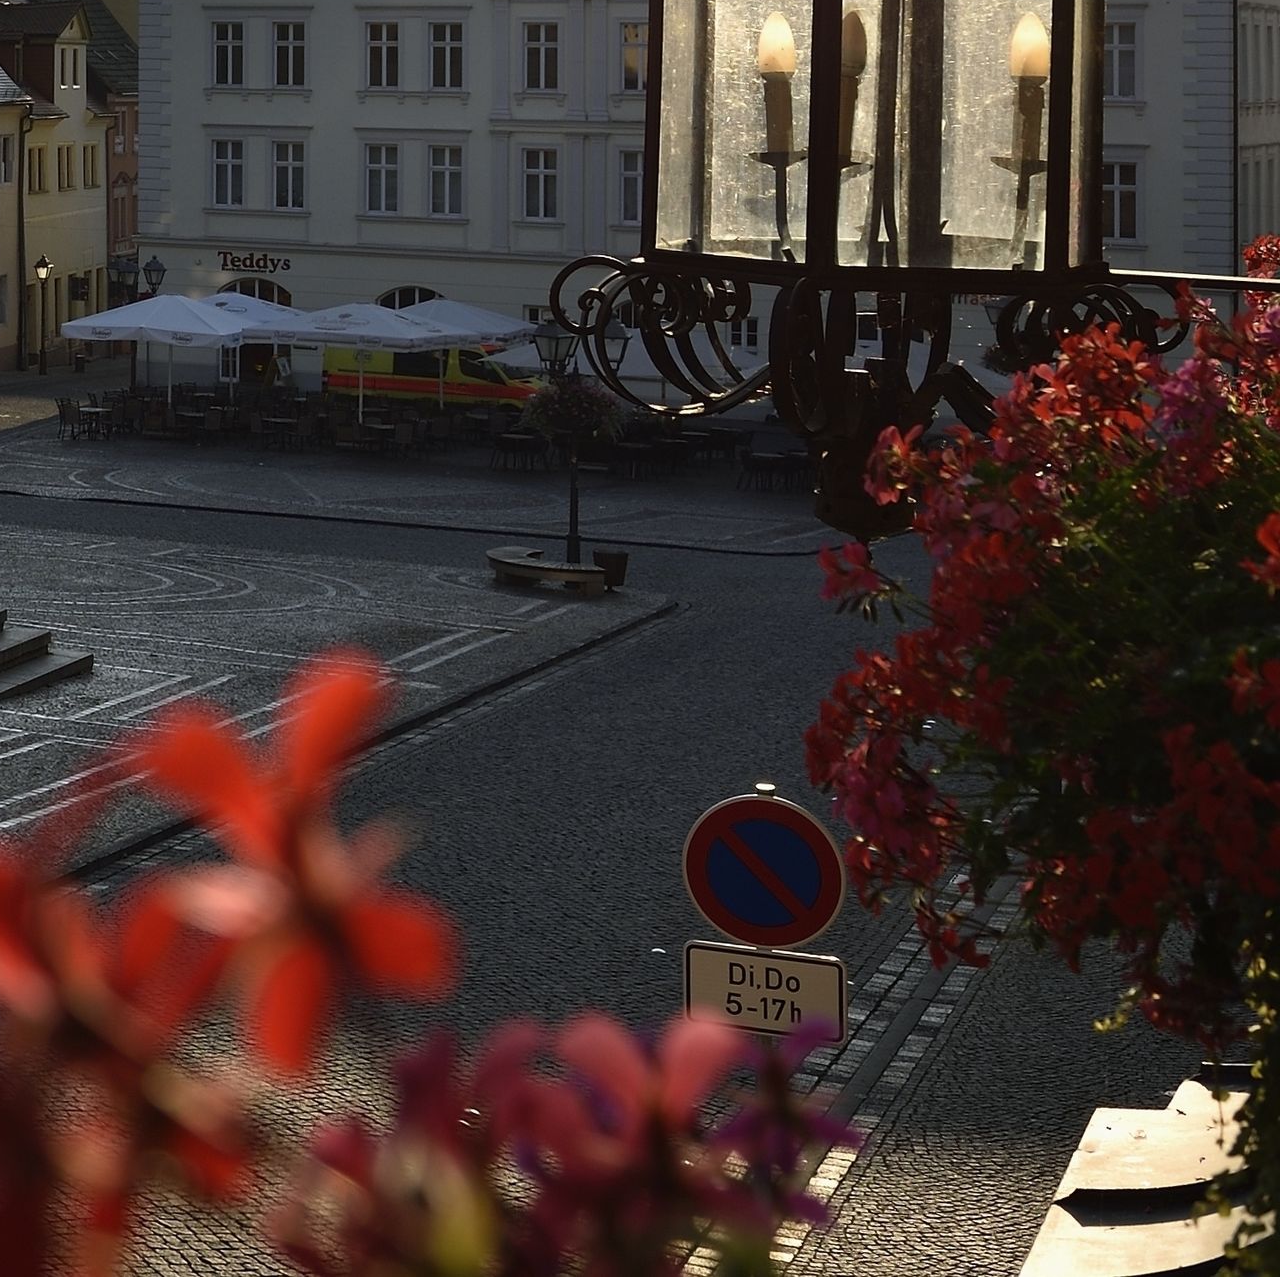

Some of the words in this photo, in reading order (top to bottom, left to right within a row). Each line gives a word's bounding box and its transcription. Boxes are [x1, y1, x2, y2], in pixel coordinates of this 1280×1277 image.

[217, 251, 291, 273] Teddys
[728, 961, 801, 993] Di,Do
[725, 992, 802, 1023] 5-17h
